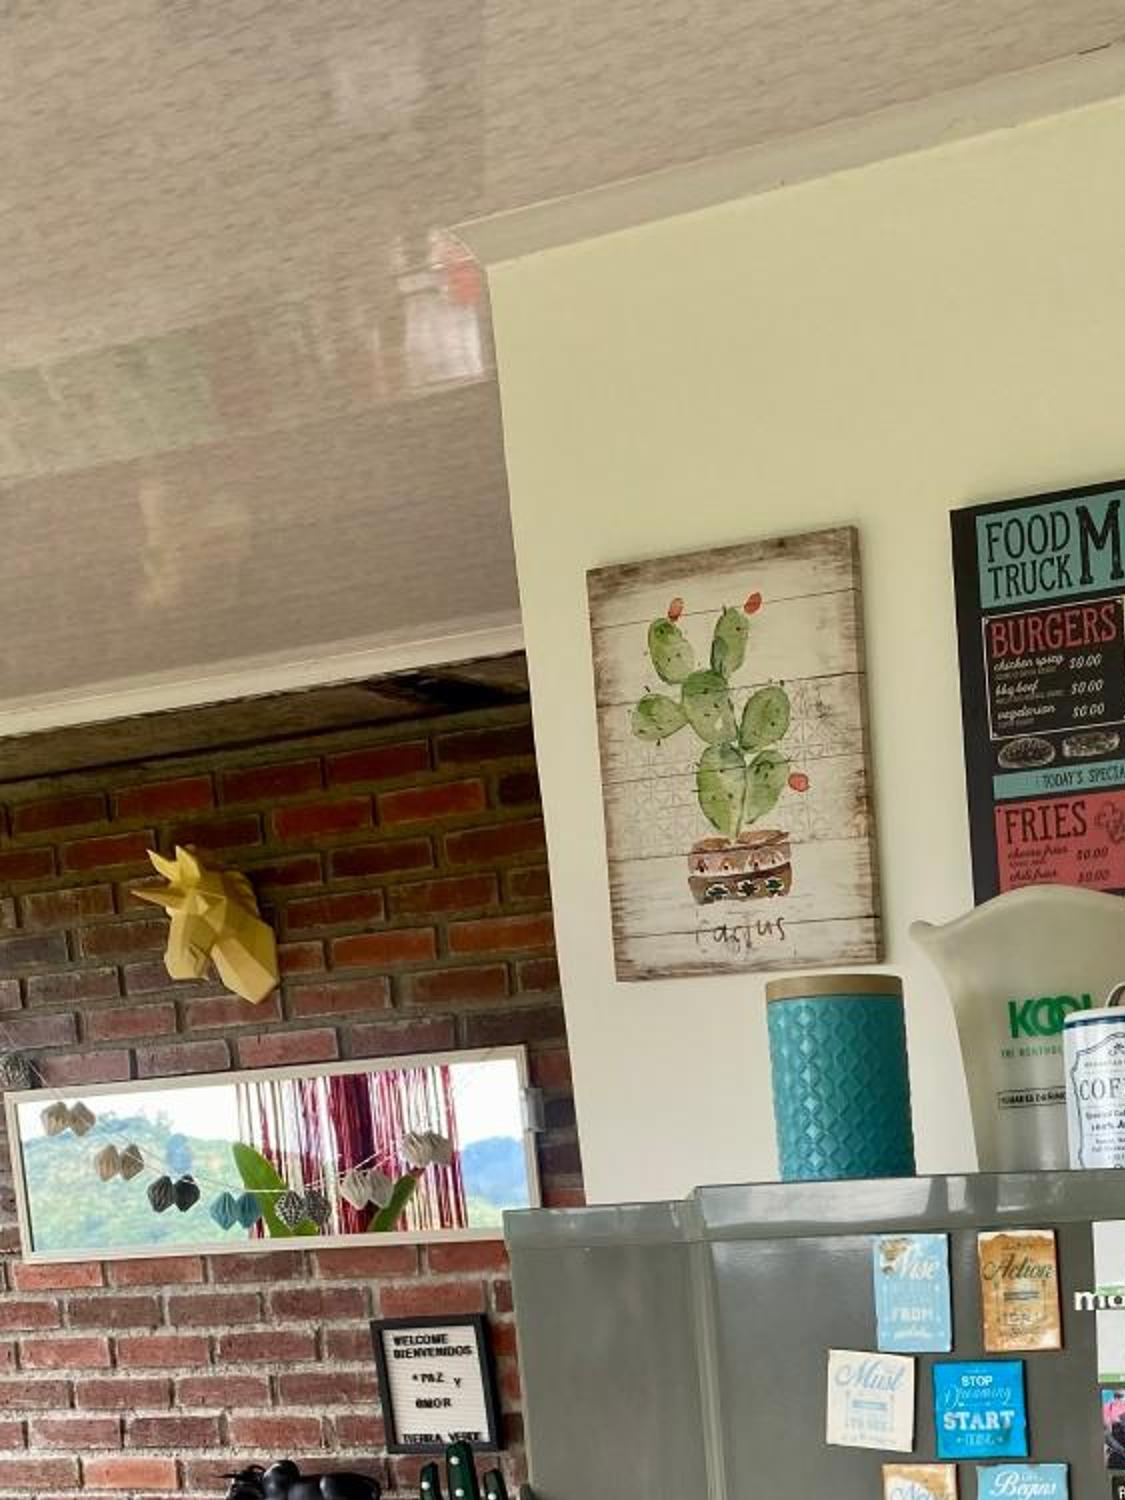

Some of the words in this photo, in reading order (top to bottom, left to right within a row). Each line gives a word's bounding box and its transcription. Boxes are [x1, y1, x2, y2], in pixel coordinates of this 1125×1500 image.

[985, 511, 1071, 563] FOOD
[988, 553, 1073, 600] TRUCK
[991, 603, 1117, 658] BURGERS
[1041, 770, 1083, 788] TODAY'S
[1005, 801, 1087, 844] FRIES
[393, 1333, 449, 1346] WELCOME
[393, 1345, 473, 1360] BIENVENIDOS
[960, 1374, 994, 1388] STOP
[943, 1409, 1016, 1431] START
